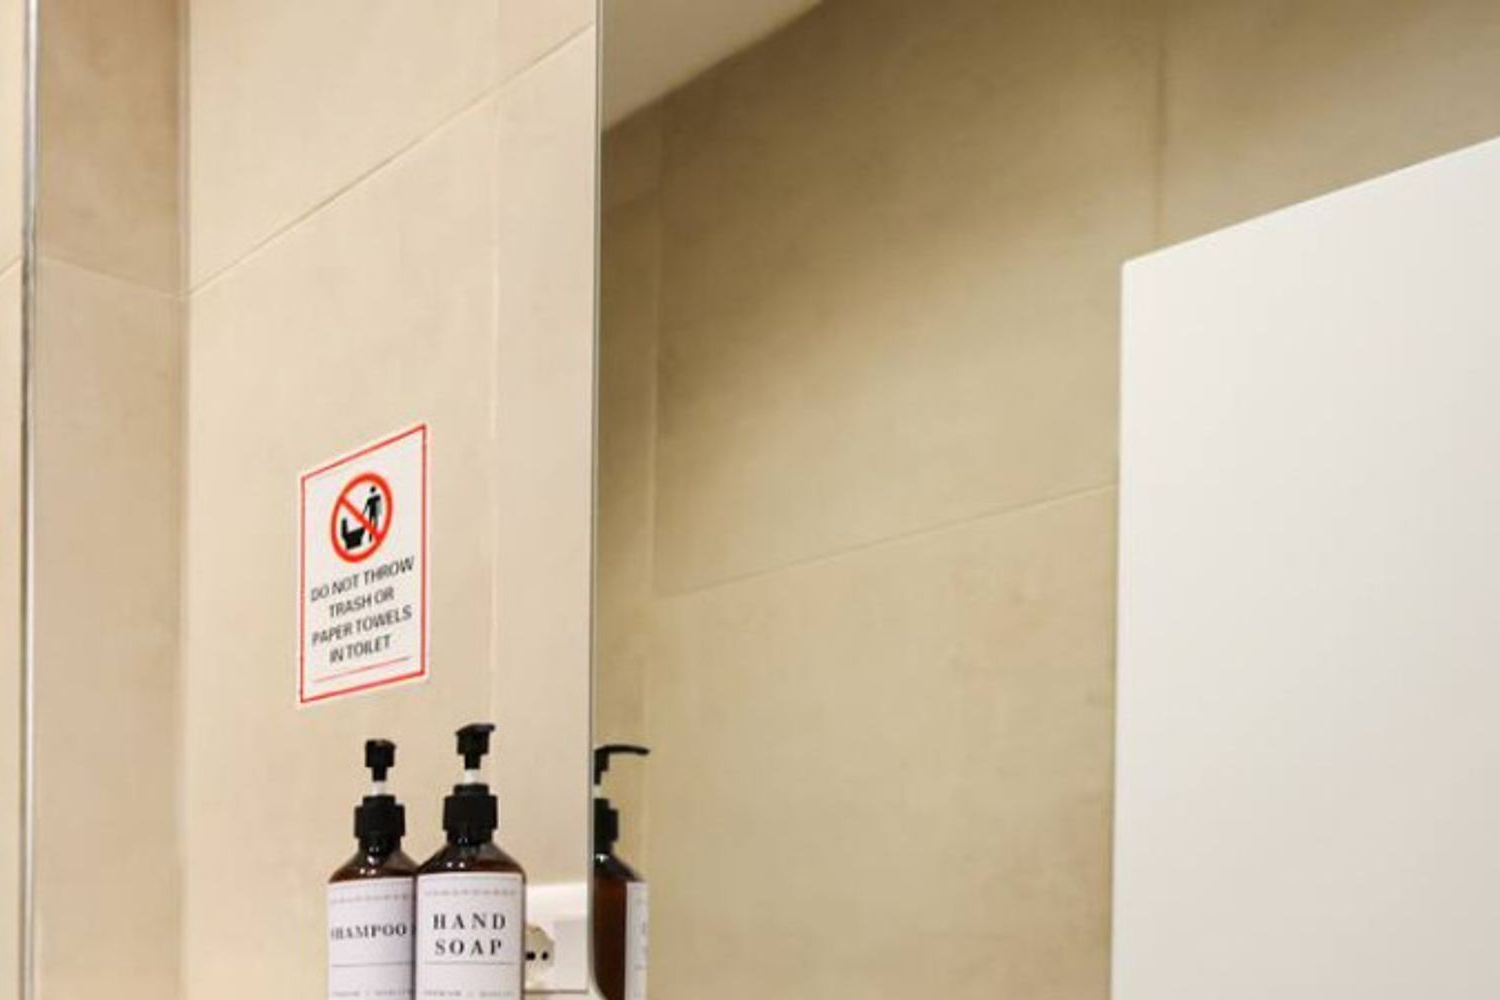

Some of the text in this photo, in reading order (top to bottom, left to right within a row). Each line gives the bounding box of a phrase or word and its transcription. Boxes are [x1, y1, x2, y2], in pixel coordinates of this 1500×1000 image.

[311, 556, 415, 602] DO NOT THROW
[328, 586, 395, 618] TRASH OR
[312, 605, 412, 646] PAPER TOWELS
[330, 634, 392, 663] IN TOILET
[433, 913, 506, 931] HAND
[435, 939, 502, 956] SOAP
